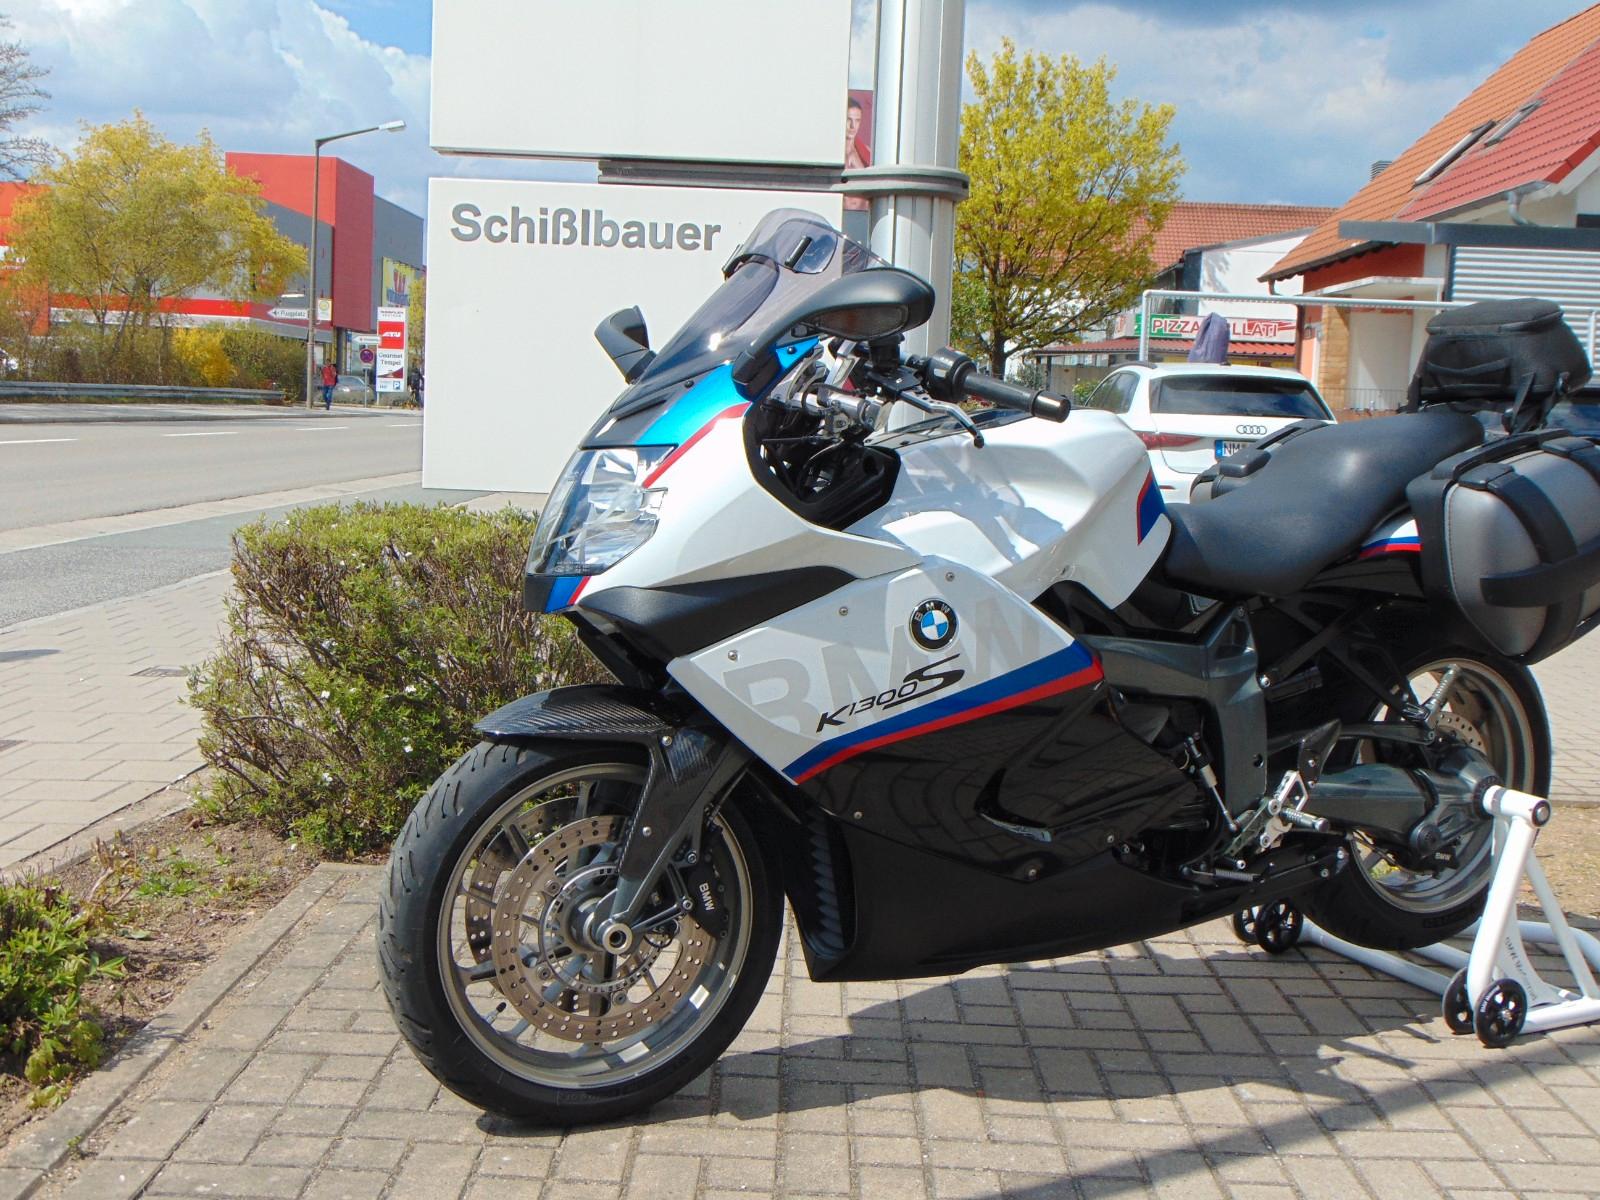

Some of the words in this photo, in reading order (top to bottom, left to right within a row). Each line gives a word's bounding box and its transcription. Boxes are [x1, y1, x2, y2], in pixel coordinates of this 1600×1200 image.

[450, 203, 721, 251] Schißlbauer
[1152, 319, 1201, 335] PIZZA
[381, 359, 402, 367] Tempel
[914, 601, 951, 621] BMW
[699, 882, 715, 911] BMW
